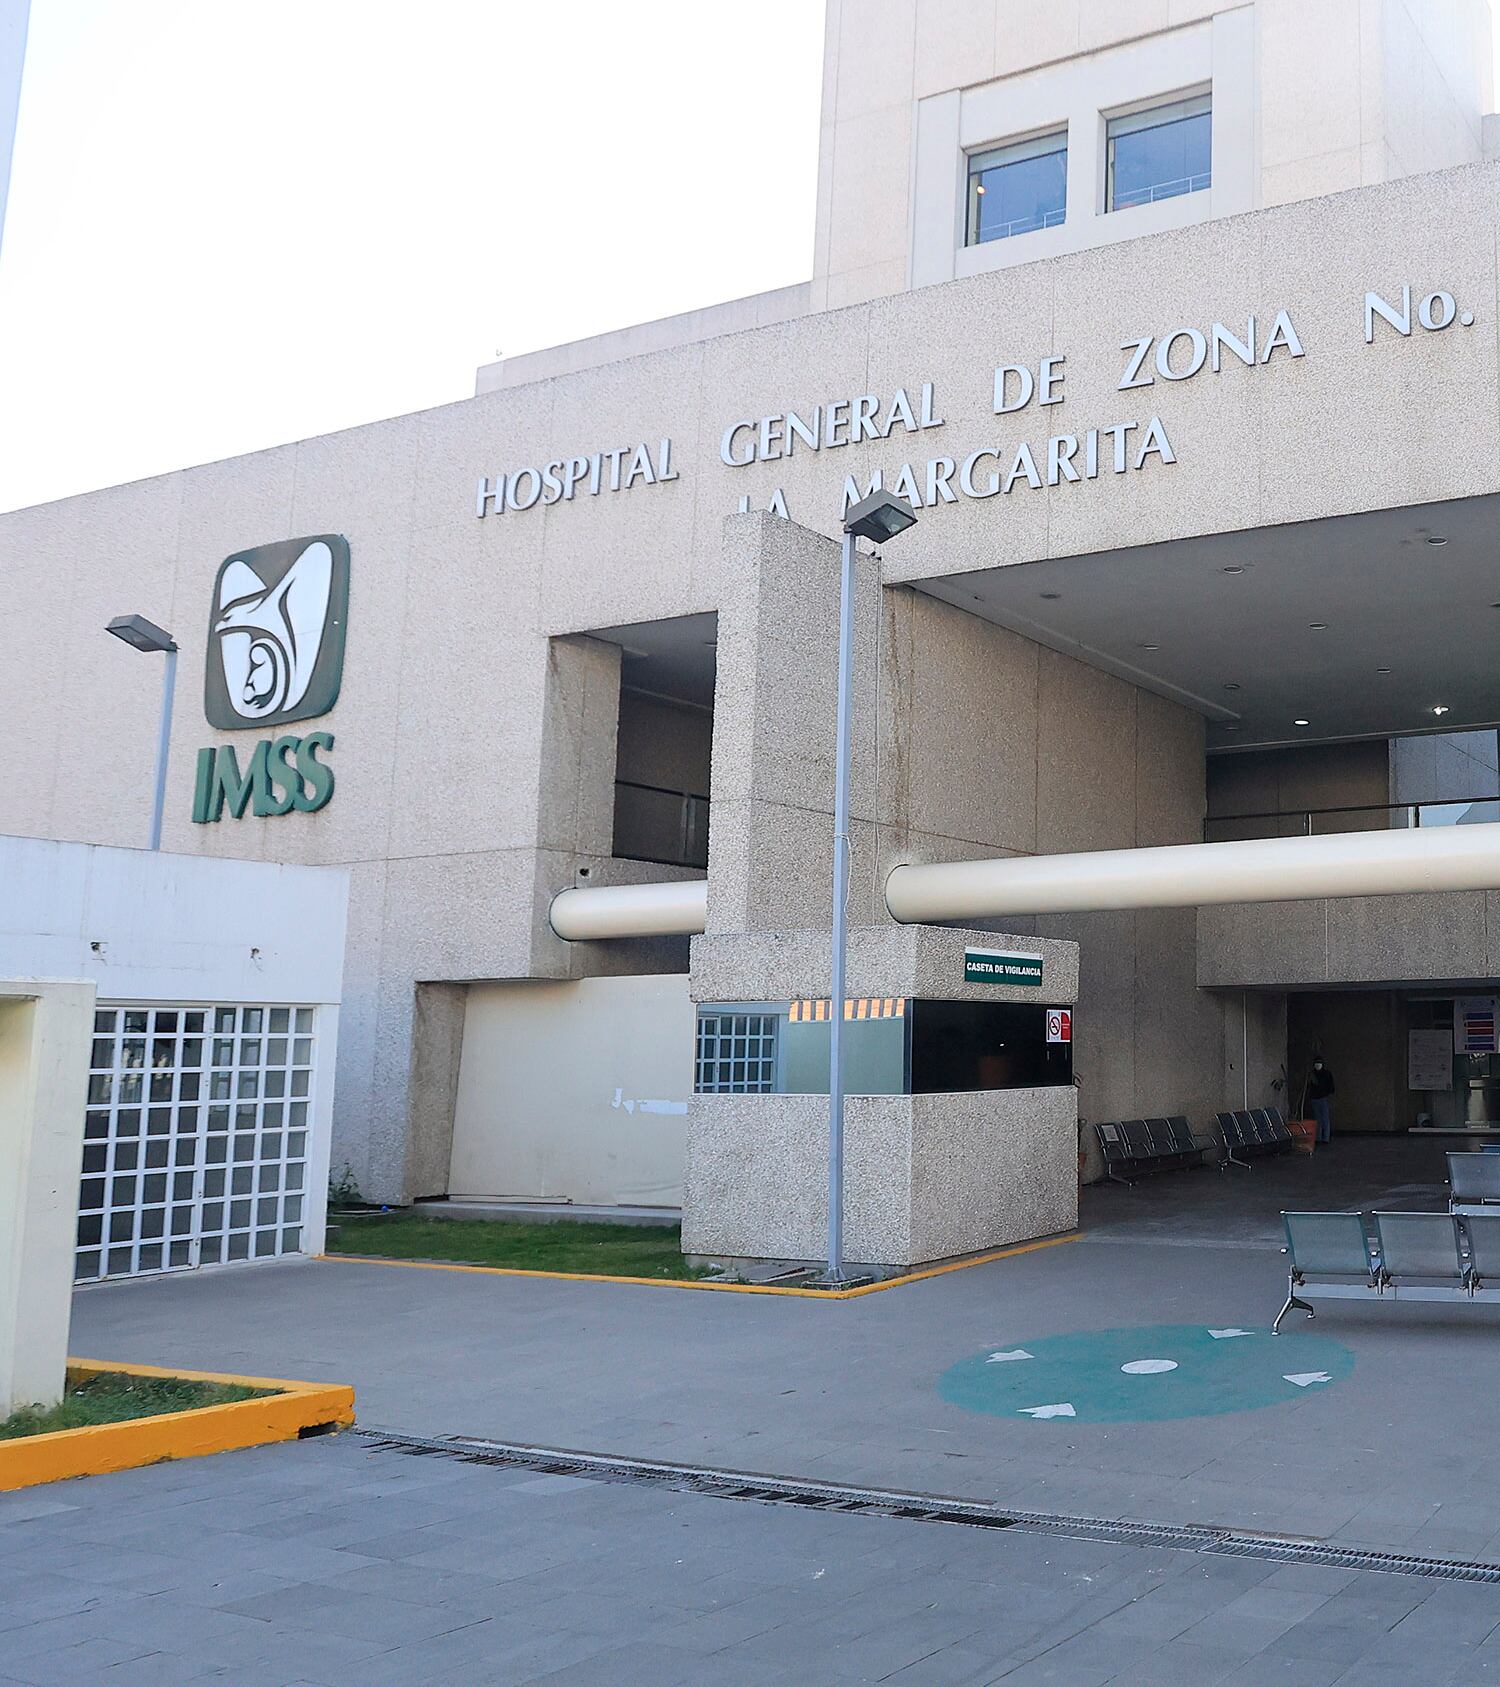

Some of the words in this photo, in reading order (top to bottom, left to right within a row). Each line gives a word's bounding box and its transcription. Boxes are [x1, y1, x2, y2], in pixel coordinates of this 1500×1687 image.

[476, 437, 680, 518] HOSPITAL
[720, 382, 945, 467] GENERAL
[993, 355, 1066, 414] DE
[1117, 309, 1306, 391] ZONA
[1363, 285, 1475, 344] No.
[839, 415, 1178, 521] MARGARITA
[191, 731, 336, 824] IMSS
[966, 961, 994, 973] CASETA
[994, 964, 1004, 974] DE
[1004, 965, 1041, 977] VIGILANCIA
